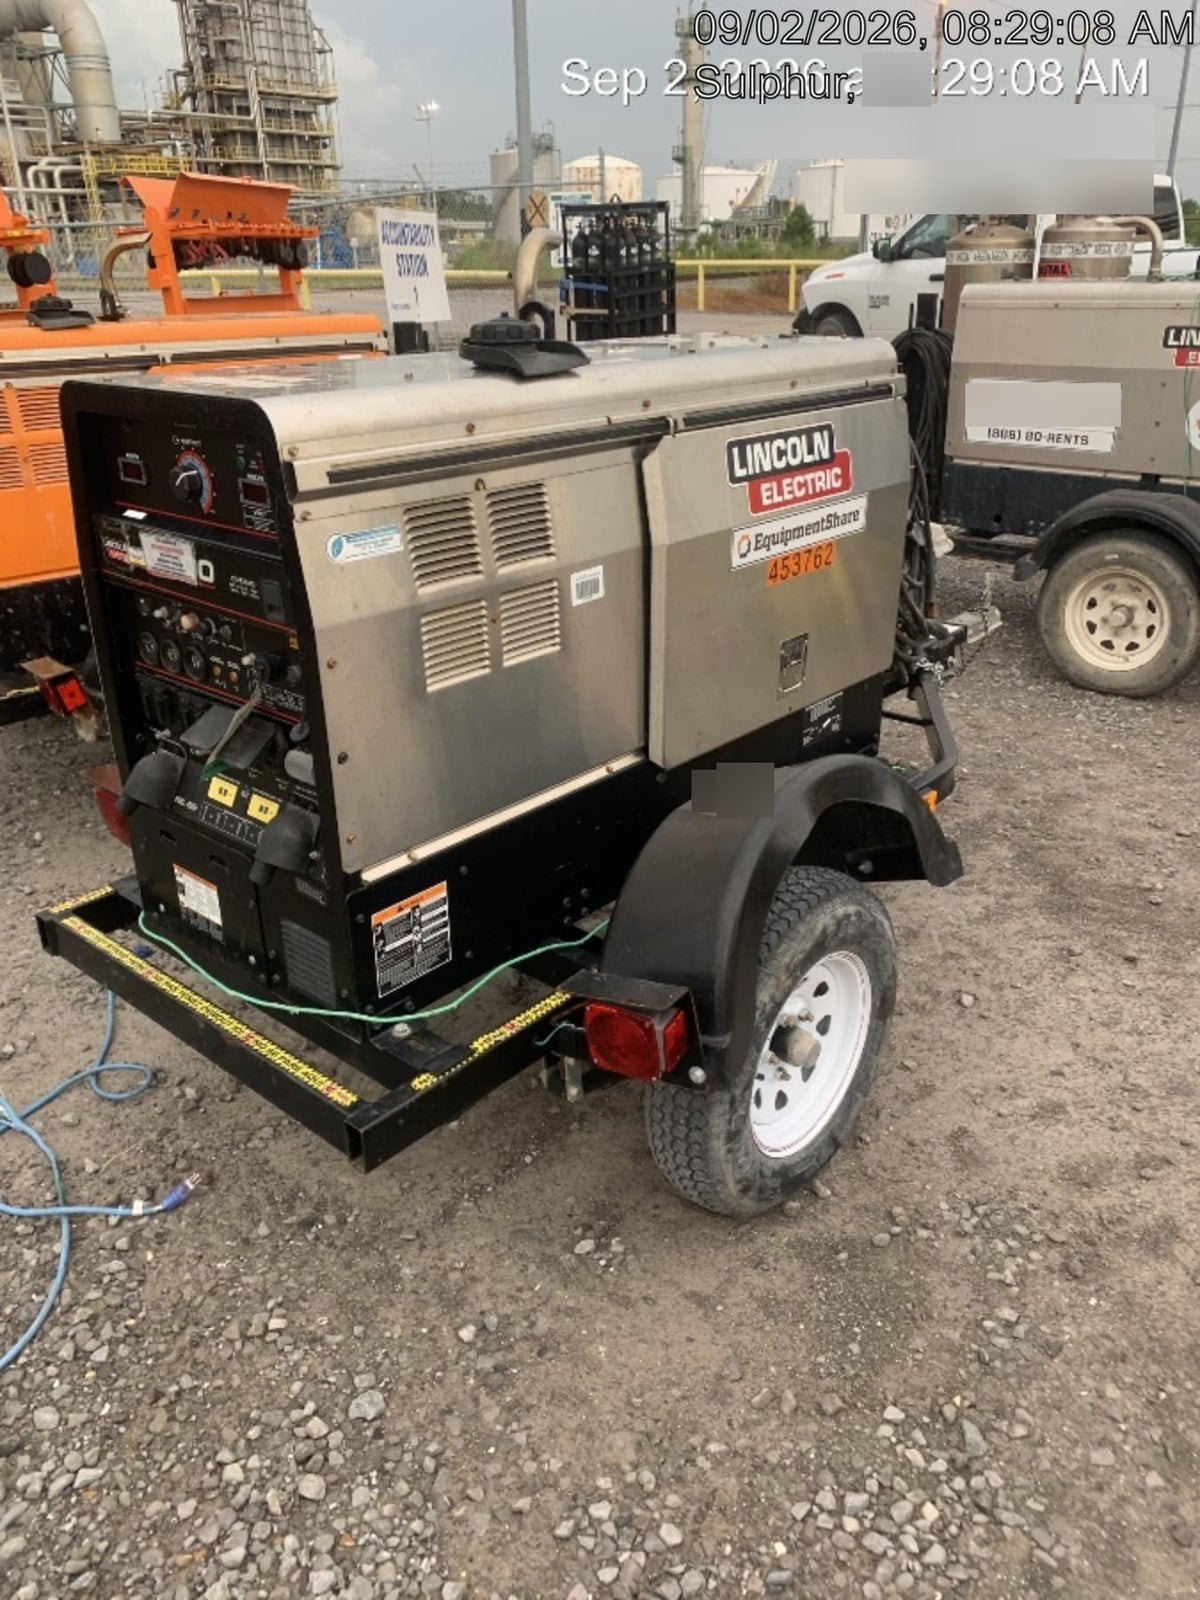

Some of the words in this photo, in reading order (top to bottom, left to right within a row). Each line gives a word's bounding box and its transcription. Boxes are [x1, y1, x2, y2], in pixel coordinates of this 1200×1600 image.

[731, 429, 831, 478] LINCOLN
[760, 466, 843, 506] ELECTRIC
[753, 509, 861, 552] EquipmentShare
[768, 543, 835, 584] 453762
